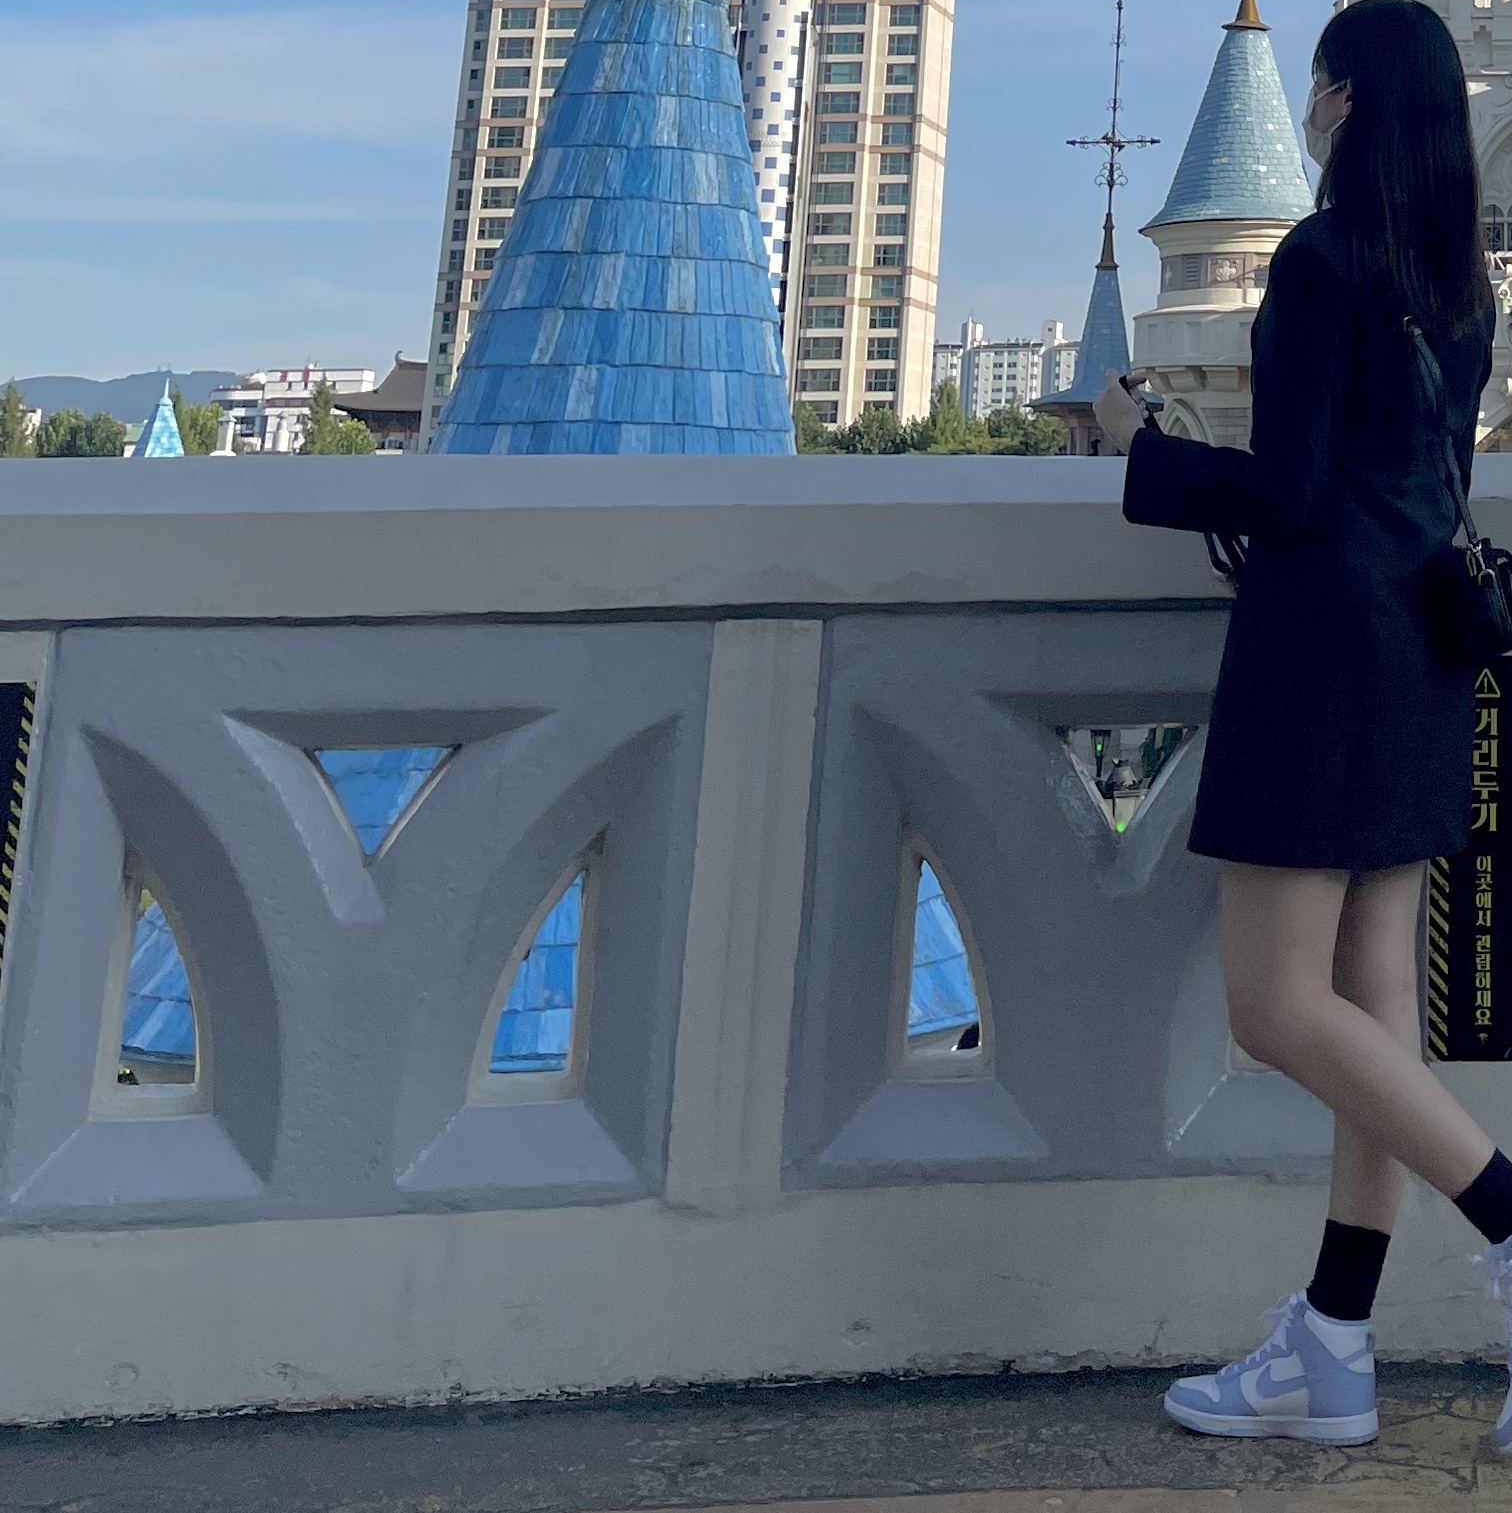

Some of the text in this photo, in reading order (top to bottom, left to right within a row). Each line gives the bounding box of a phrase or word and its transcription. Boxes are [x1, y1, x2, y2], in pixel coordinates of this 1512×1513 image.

[1470, 707, 1500, 833] 거리두기
[1475, 855, 1493, 1026] 이곳에서 관람하세요
